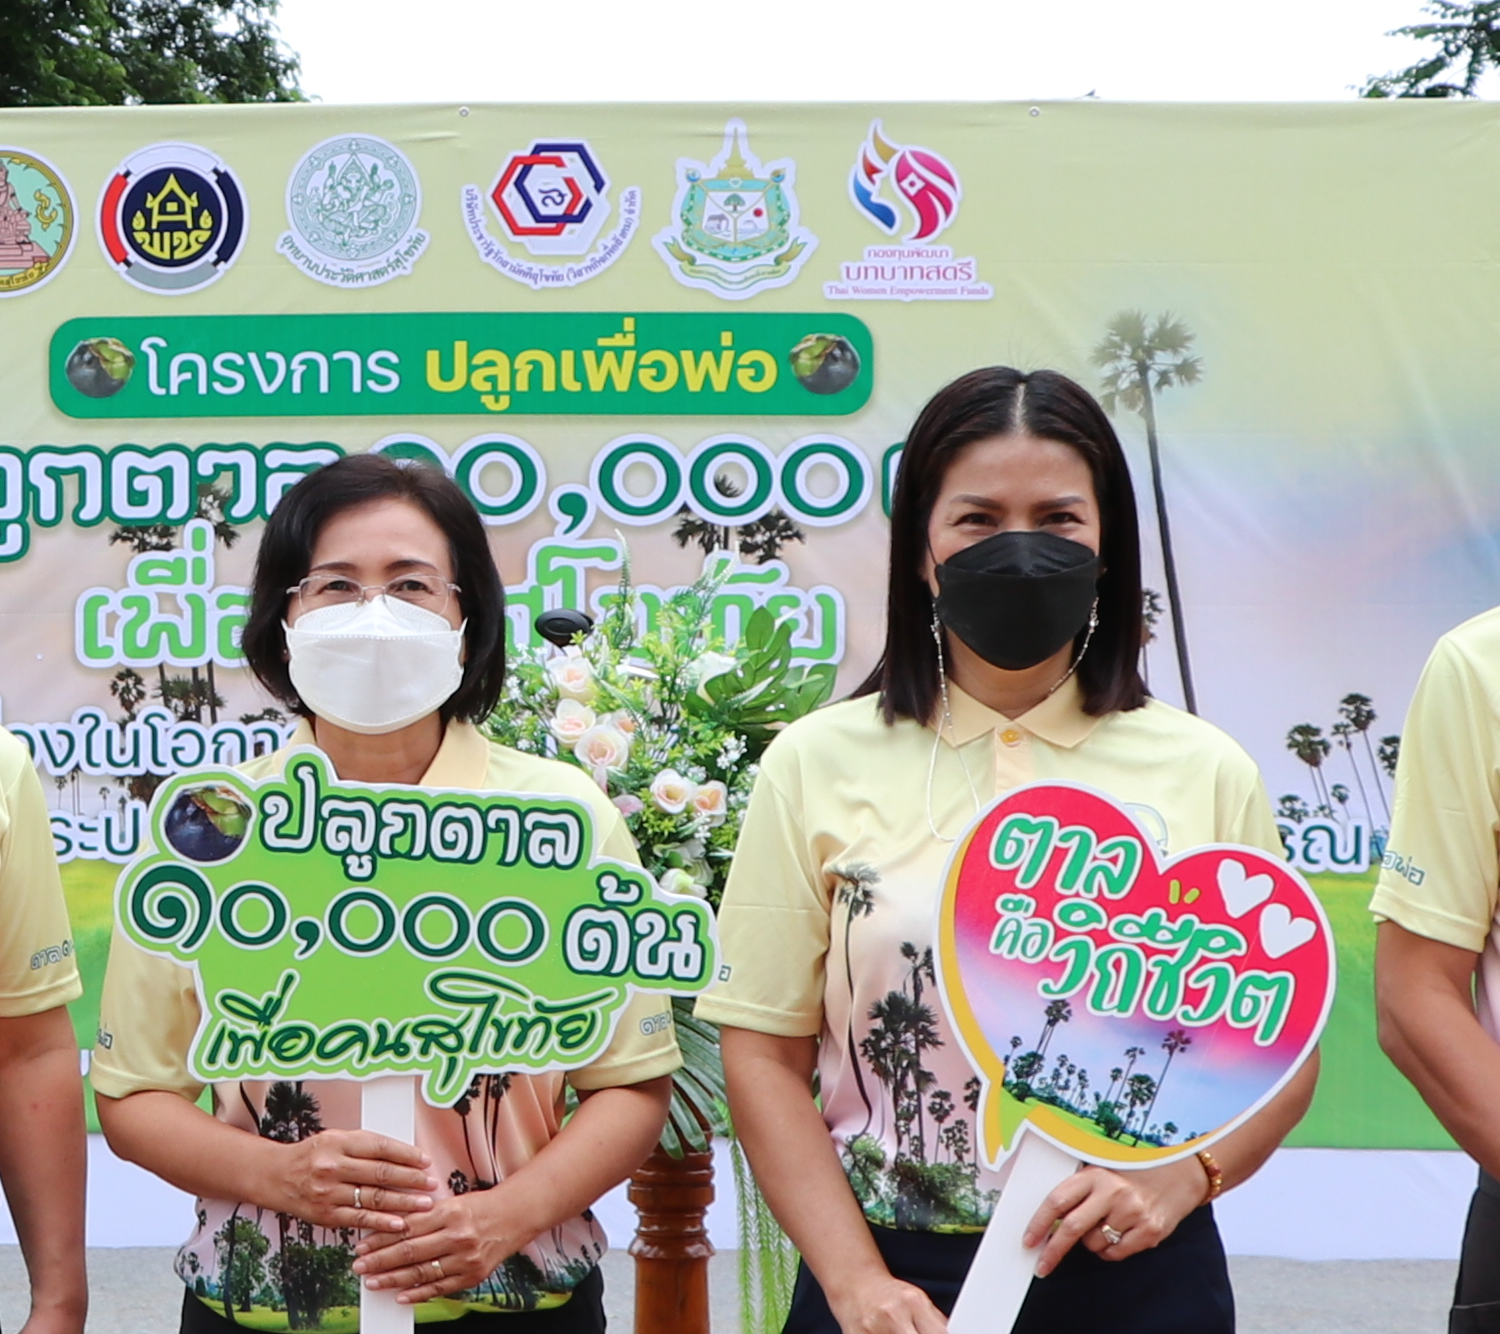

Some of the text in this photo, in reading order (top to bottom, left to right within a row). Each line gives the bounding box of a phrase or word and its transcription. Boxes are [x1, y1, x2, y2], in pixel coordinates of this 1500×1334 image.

[828, 285, 849, 296] Thai
[852, 285, 888, 296] Women
[845, 261, 973, 282] บทบาทสตรี
[141, 317, 778, 411] โครงการ ปลูกเพื่อพ่อ
[260, 765, 583, 880] ปลูกตาล
[992, 816, 1140, 898] ตาล
[130, 864, 703, 980] ๑๐,๐๐๐ ต้น
[206, 972, 617, 1093] เพื่อคนสุโขทัย
